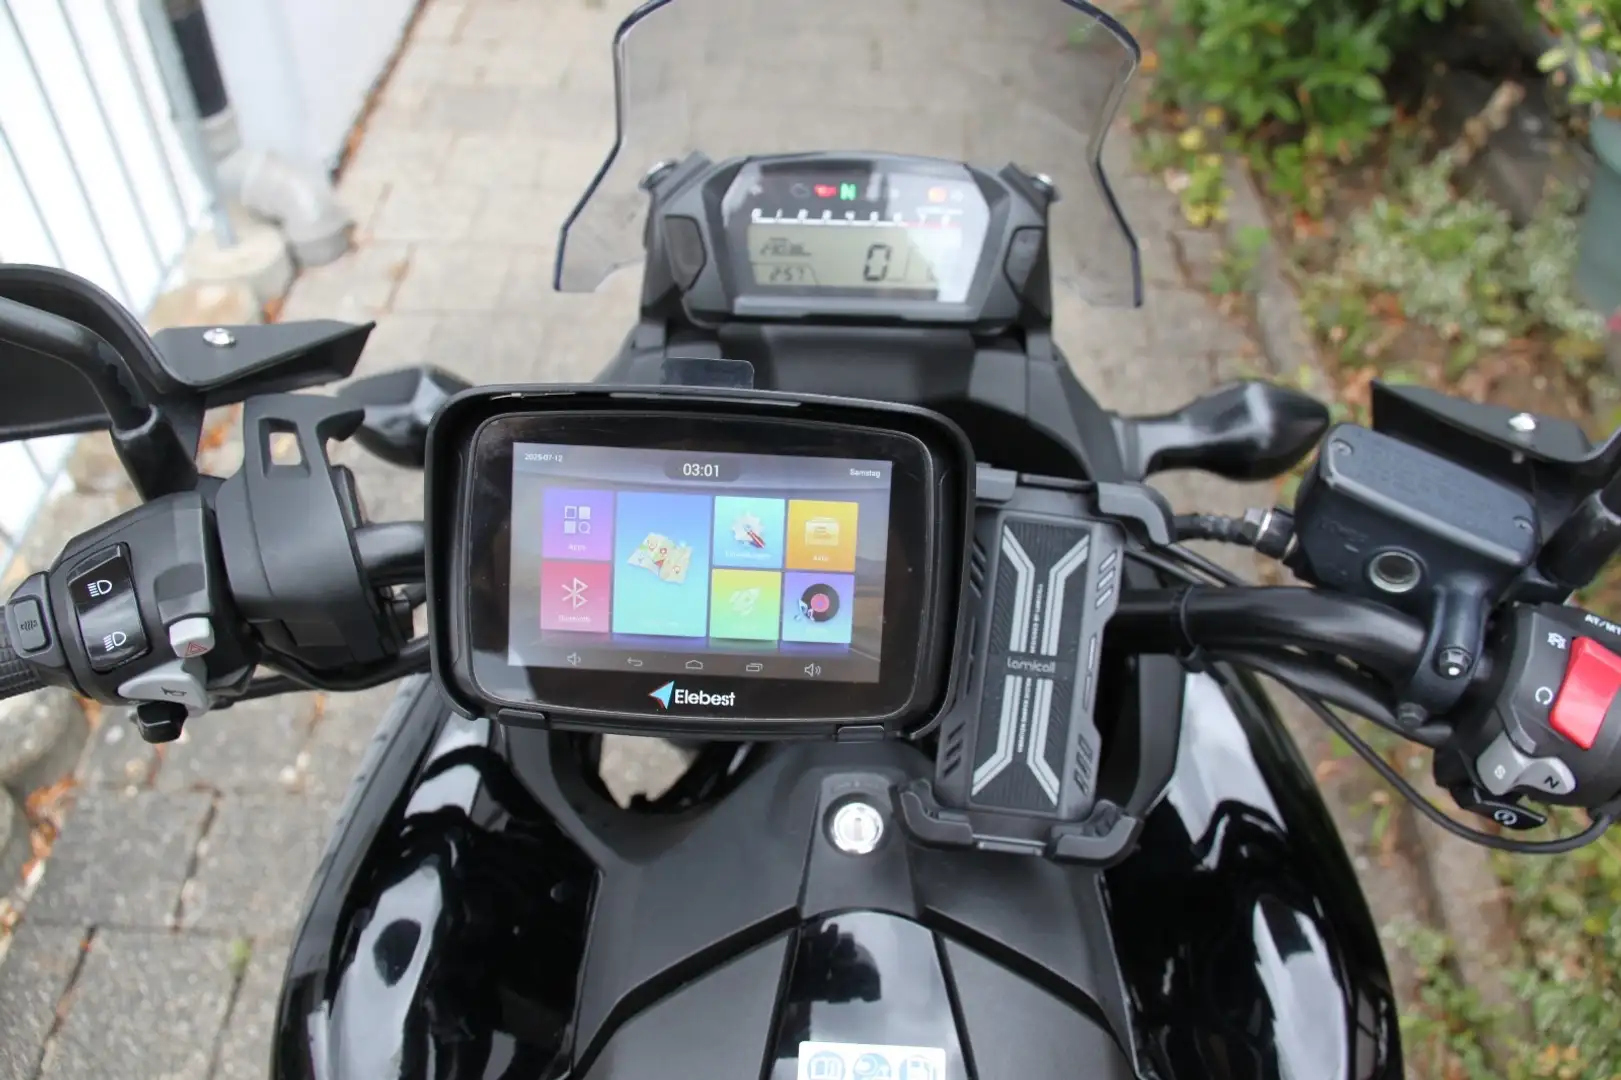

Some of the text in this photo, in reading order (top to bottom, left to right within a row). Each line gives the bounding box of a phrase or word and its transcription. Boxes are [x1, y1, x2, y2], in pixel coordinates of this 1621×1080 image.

[840, 183, 856, 200] N
[683, 463, 720, 478] 03:01
[849, 468, 881, 478] Samstag
[674, 688, 735, 706] Elebest
